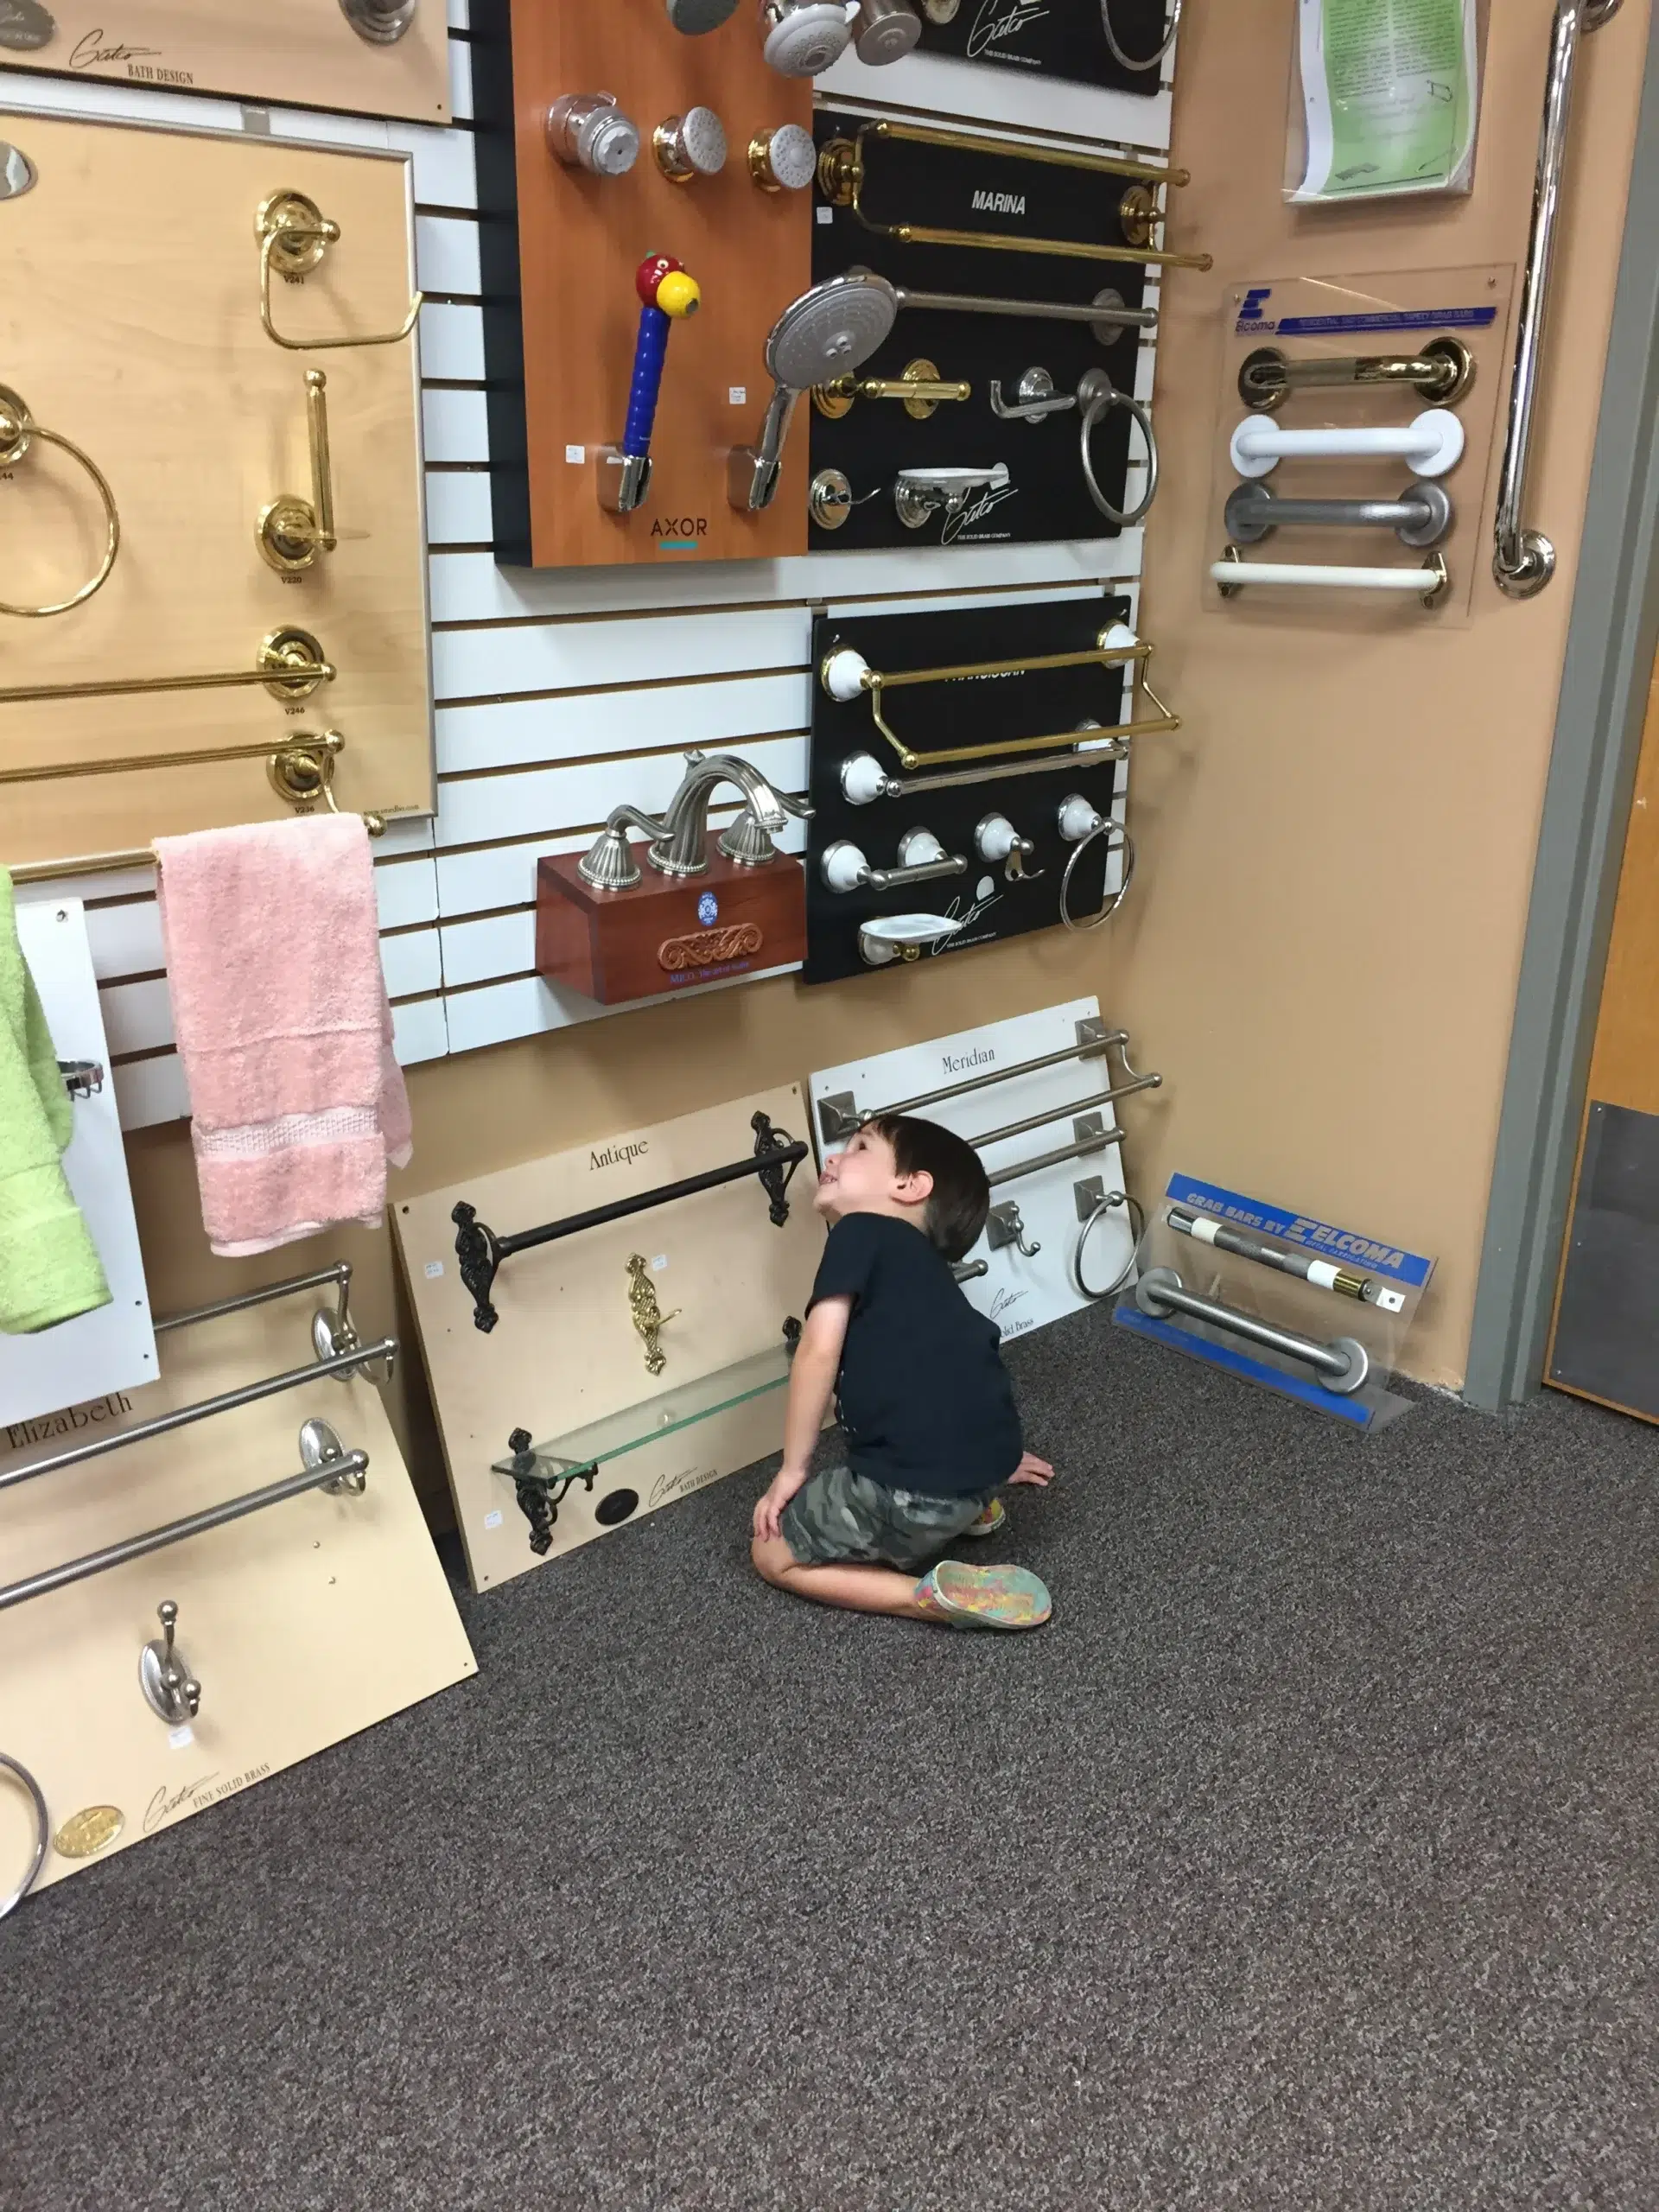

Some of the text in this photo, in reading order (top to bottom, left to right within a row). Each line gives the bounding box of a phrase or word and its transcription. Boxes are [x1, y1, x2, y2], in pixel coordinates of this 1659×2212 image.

[69, 29, 162, 68] Gatco
[128, 63, 194, 85] BATH DESIGN
[971, 190, 1026, 215] MARINA
[650, 518, 708, 537] AXOR
[942, 1046, 995, 1075] Meridian
[589, 1141, 650, 1171] Antique
[1186, 1192, 1405, 1269] GRAB BARS BY ELCOMA
[1001, 1318, 1034, 1338] olid Brass
[5, 1392, 134, 1449] Elizabeth
[679, 1480, 696, 1493] BATH
[696, 1469, 718, 1486] DESIGN
[193, 1762, 271, 1808] FINE SOLID BRASS
